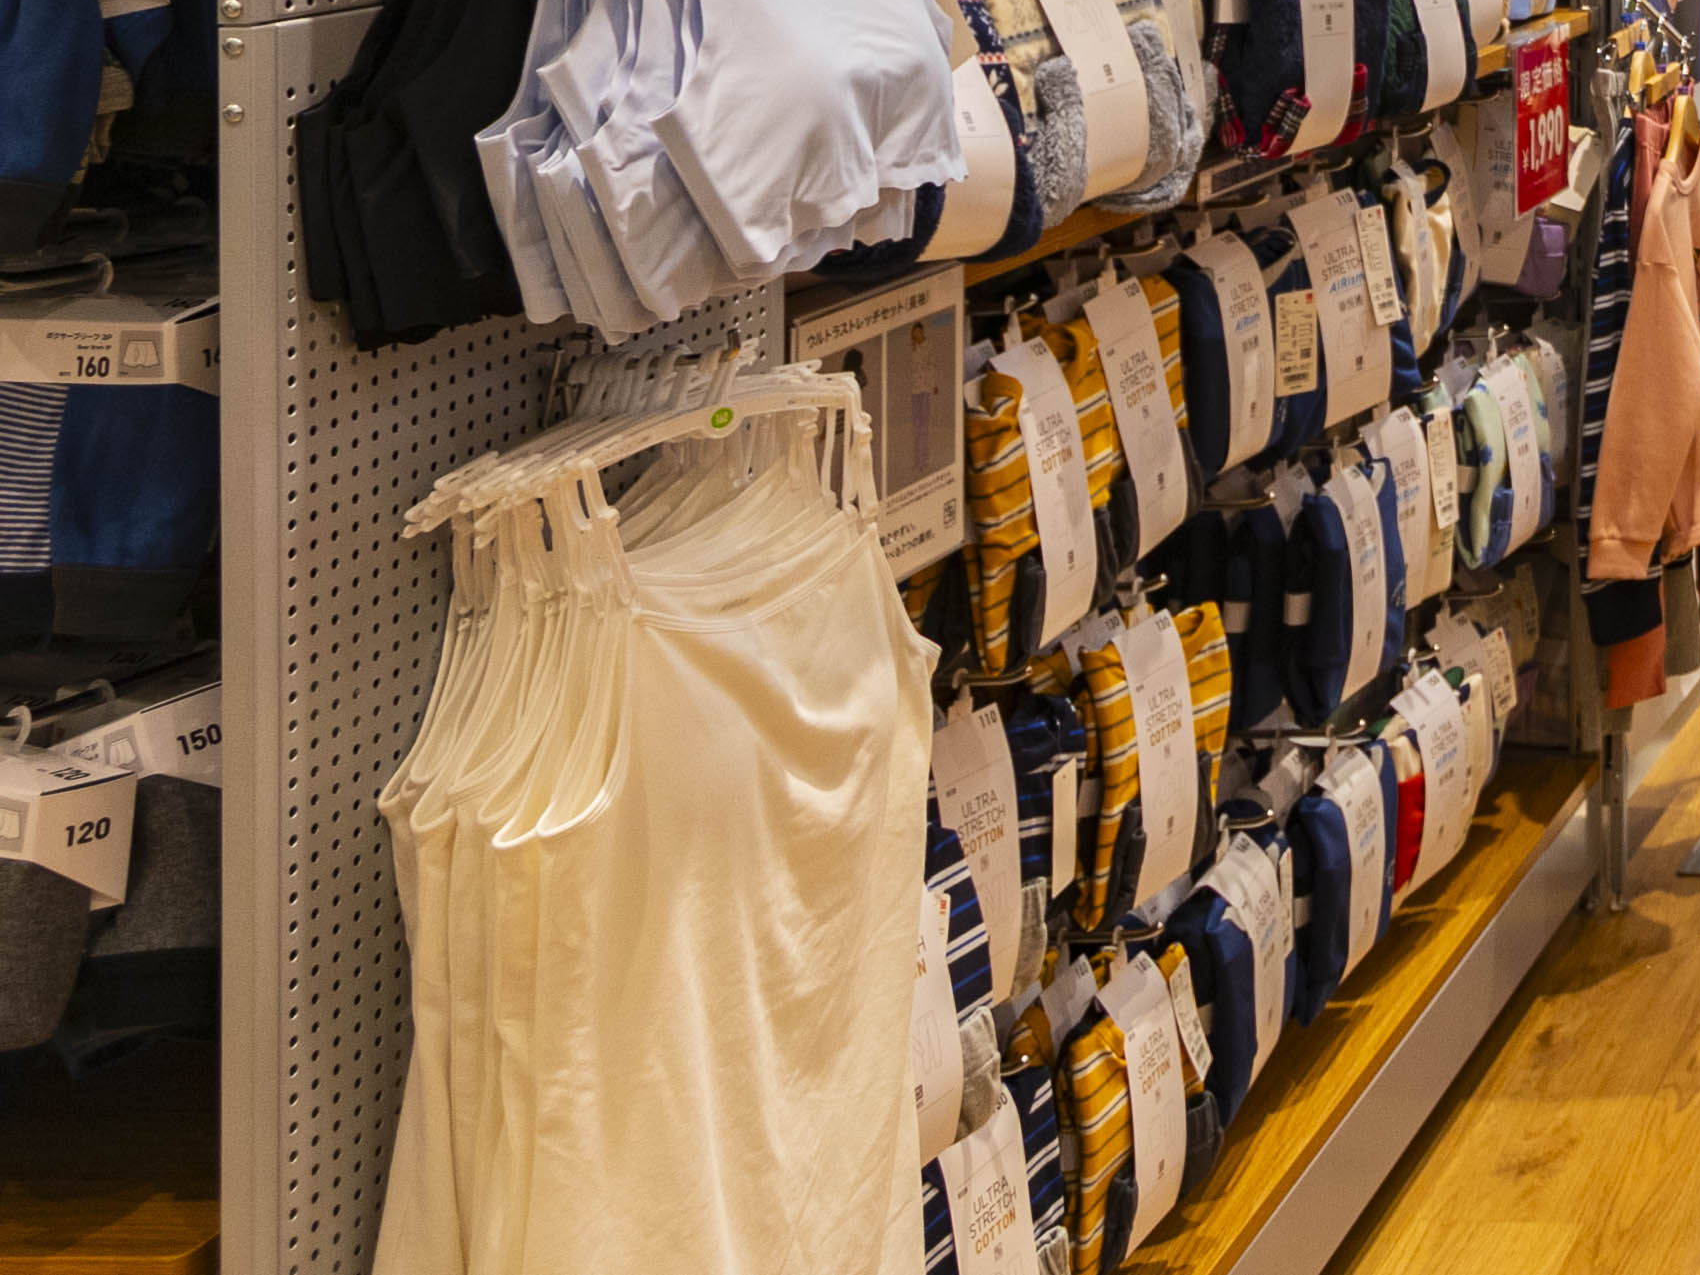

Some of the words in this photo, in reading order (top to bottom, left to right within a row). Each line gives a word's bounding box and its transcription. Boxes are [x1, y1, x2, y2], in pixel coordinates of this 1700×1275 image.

[1520, 57, 1564, 101] 限定価格
[1522, 104, 1564, 175] ¥1,990
[1321, 256, 1363, 281] STRETCH
[1324, 245, 1354, 265] ULTRA
[76, 356, 110, 377] 160
[1119, 362, 1155, 395] STRETCH
[1120, 350, 1148, 377] ULTRA
[1127, 379, 1157, 410] COTTON
[1147, 685, 1176, 710] ULTRA
[979, 711, 998, 729] 110
[1145, 701, 1184, 730] STRETCH
[176, 723, 222, 756] 150
[1150, 719, 1182, 747] COTTON
[961, 789, 998, 819] ULTRA
[65, 817, 111, 847] 120
[958, 805, 1007, 839] STRETCH
[962, 826, 1005, 859] COTTON
[1137, 1044, 1169, 1075] STRETCH
[1139, 1031, 1165, 1057] ULTRA
[1142, 1062, 1172, 1095] COTTON
[974, 1177, 1008, 1214] ULTRA
[968, 1187, 1018, 1239] STRETCH
[975, 1210, 1017, 1255] COTTON
